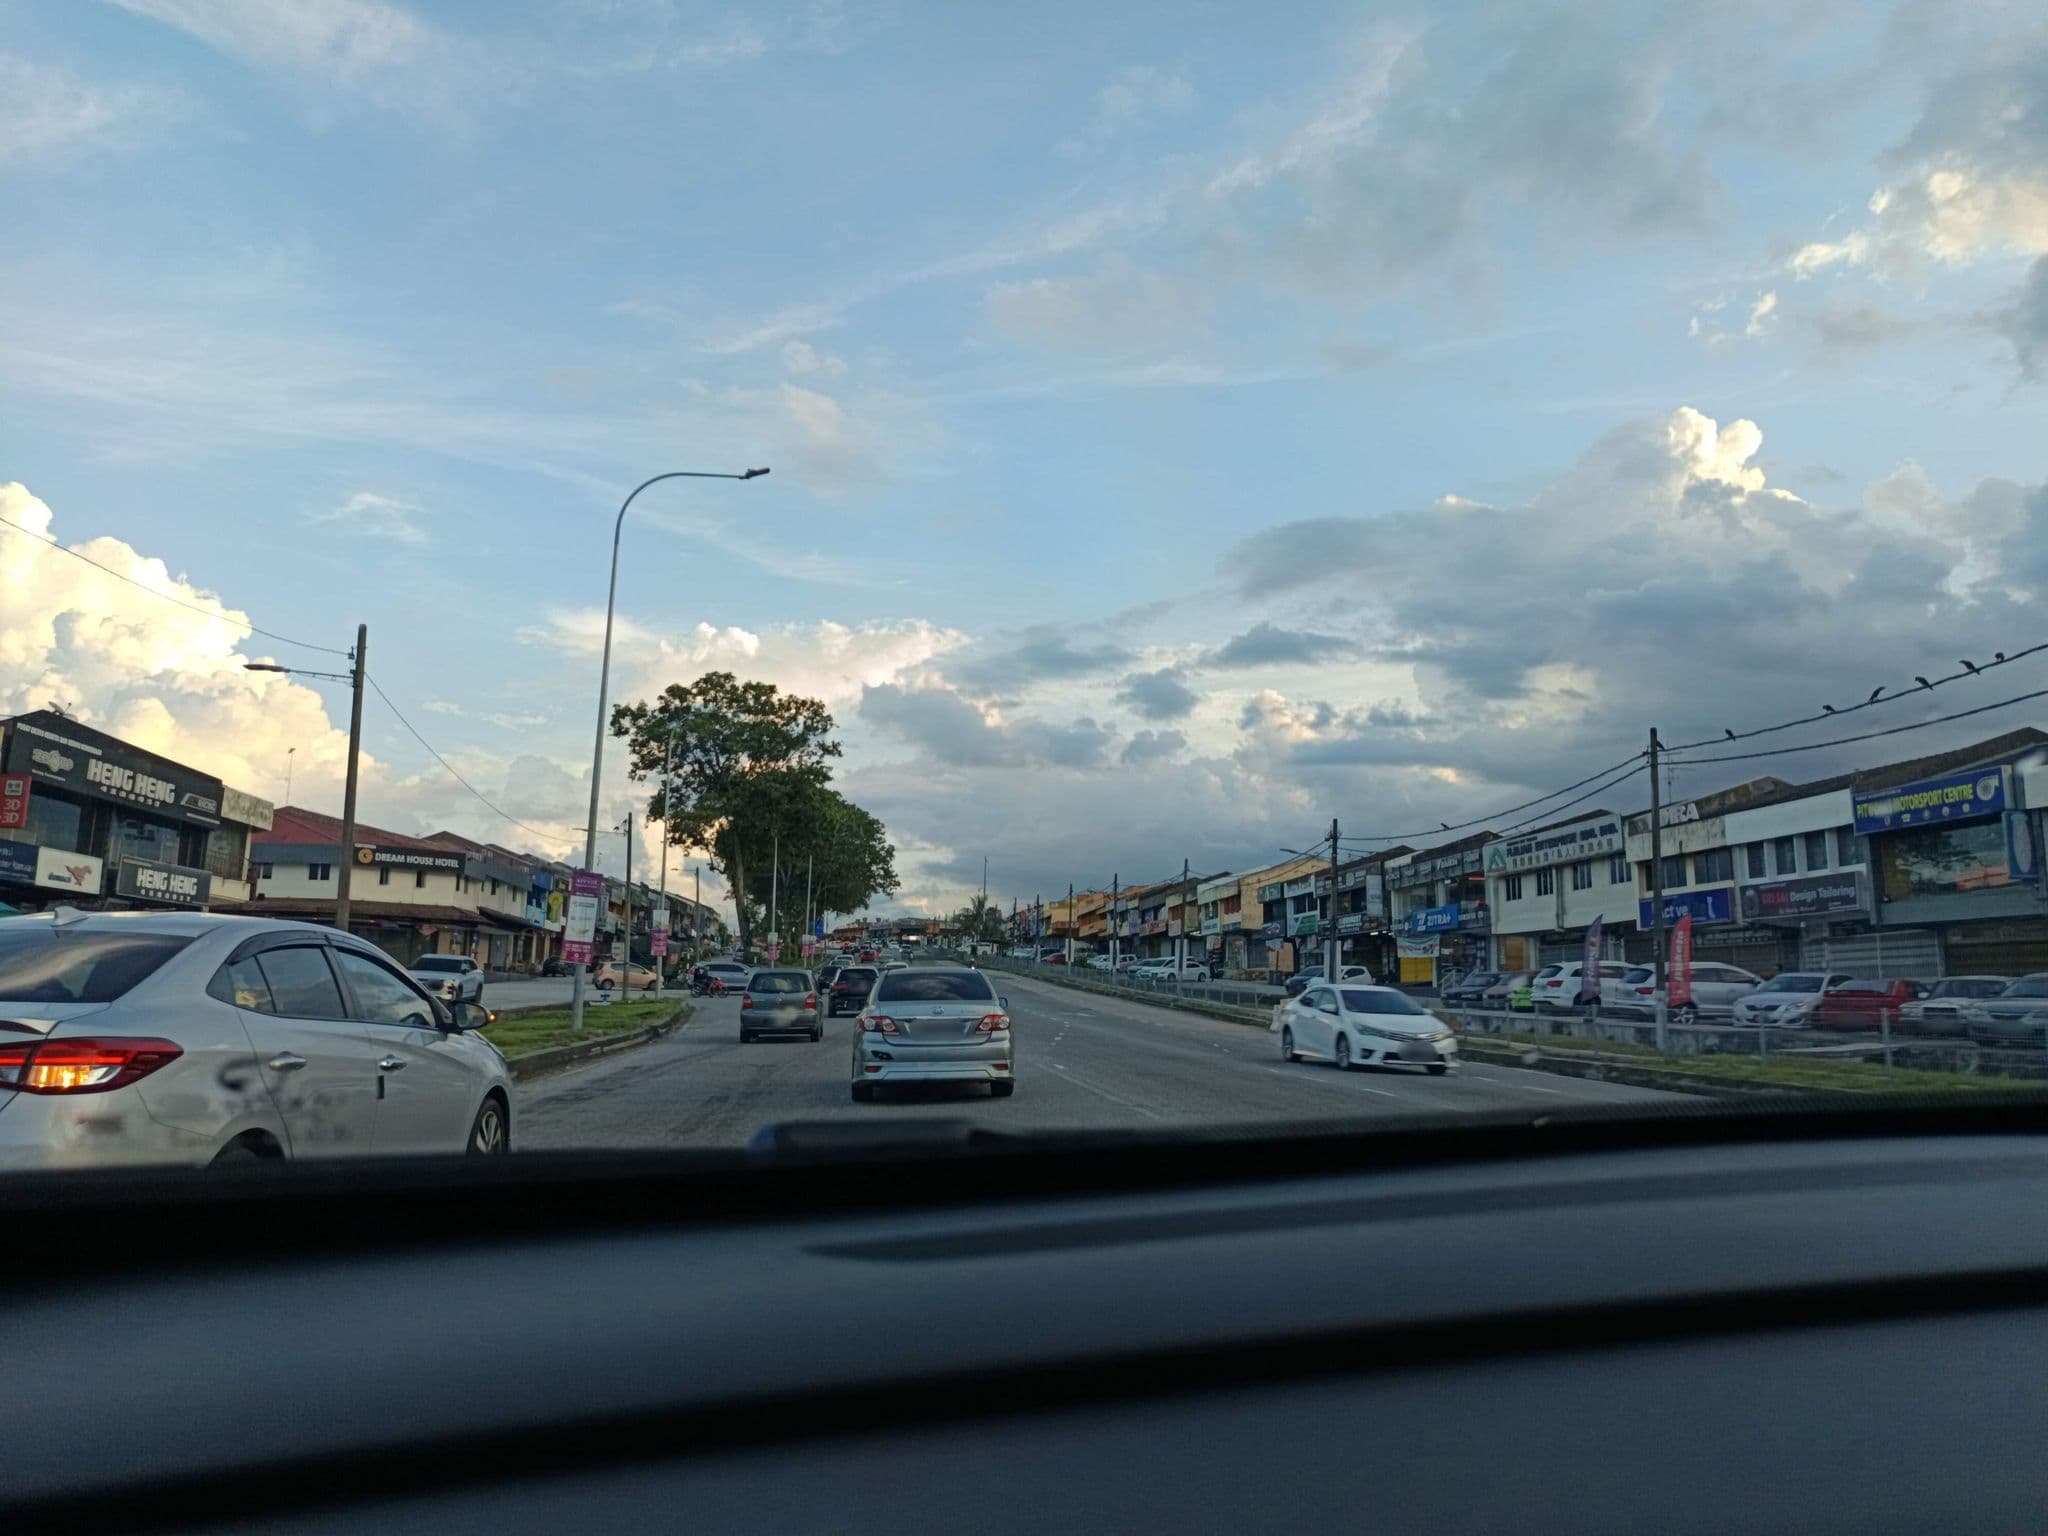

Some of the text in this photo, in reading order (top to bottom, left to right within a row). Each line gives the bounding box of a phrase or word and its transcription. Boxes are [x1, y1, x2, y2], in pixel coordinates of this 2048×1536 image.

[87, 758, 134, 791] HENG
[133, 773, 176, 804] HENG
[1892, 790, 1942, 811] MOTORSPORT
[1943, 784, 1974, 803] CENTRE
[375, 852, 459, 868] DREAM HOUSE HOTEL
[136, 867, 198, 896] HENG HENG
[1817, 886, 1855, 899] Tailoring
